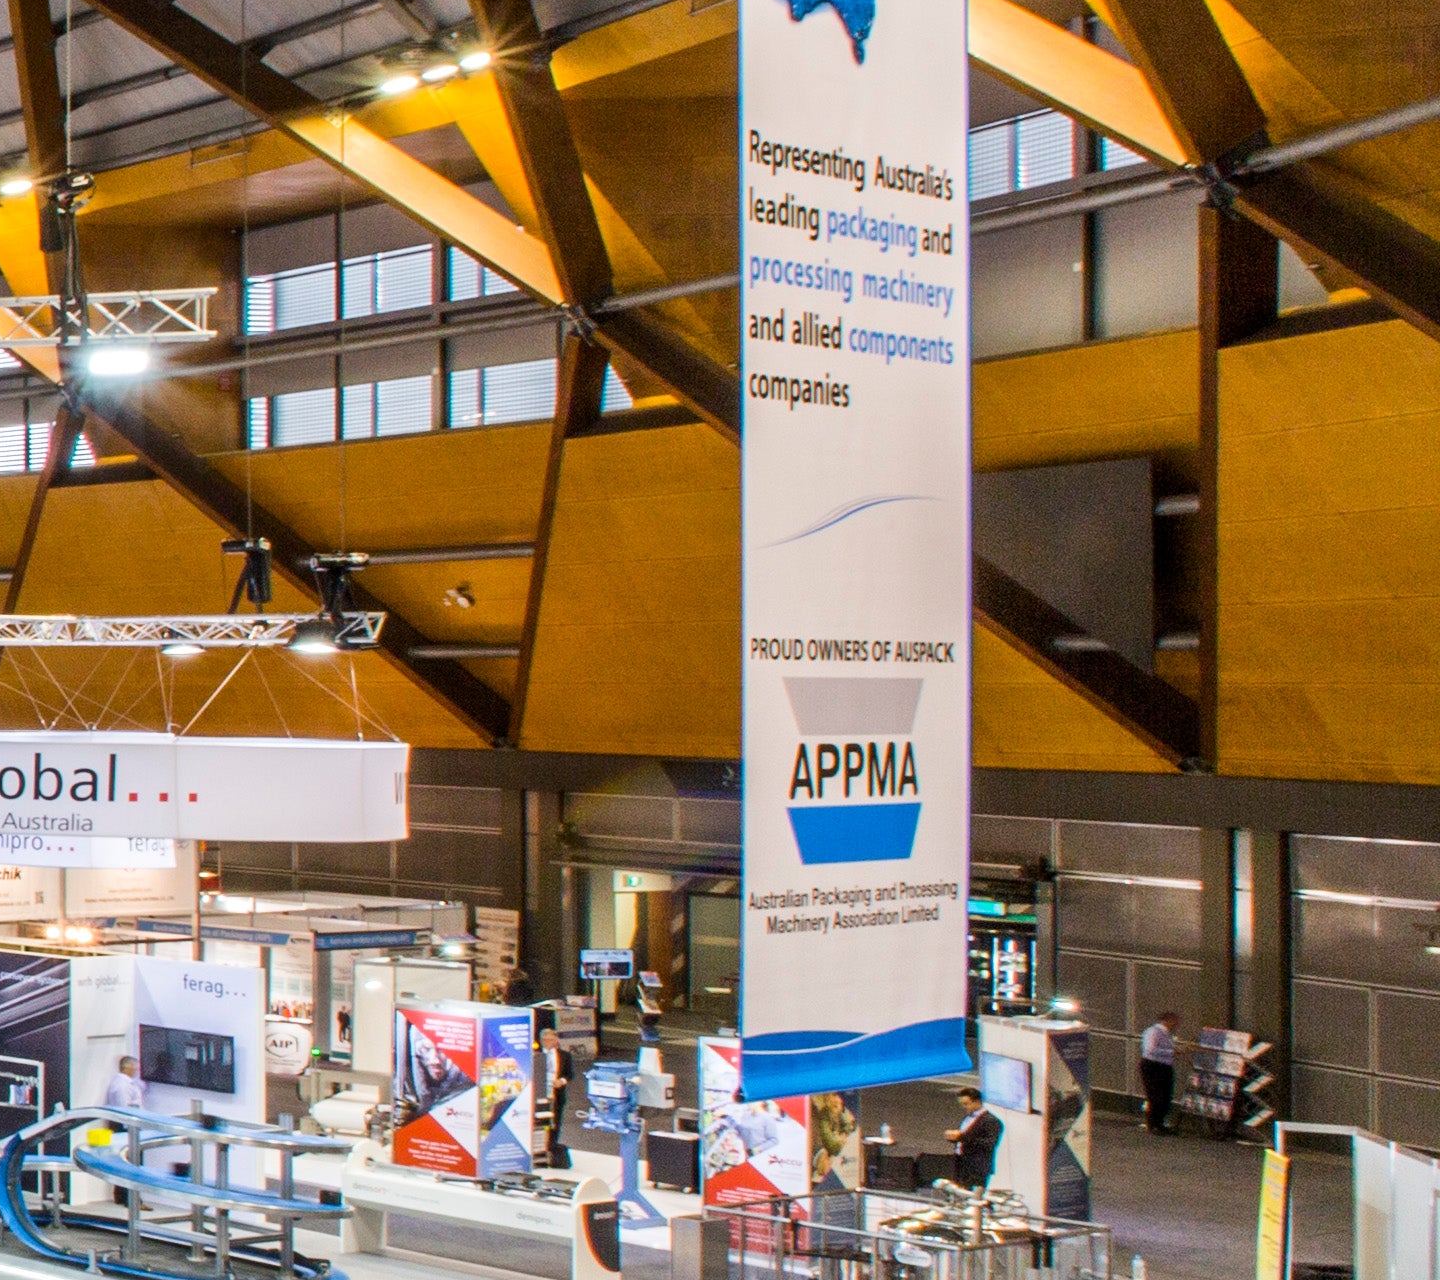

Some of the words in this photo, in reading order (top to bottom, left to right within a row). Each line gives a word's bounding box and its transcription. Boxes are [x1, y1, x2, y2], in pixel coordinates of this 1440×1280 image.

[749, 129, 864, 192] Representing
[874, 156, 953, 201] Australia's
[750, 186, 820, 241] leading
[827, 206, 917, 258] packaging
[922, 224, 952, 255] and
[750, 254, 852, 303] processing
[863, 270, 953, 318] machinery
[749, 308, 784, 341] and
[792, 311, 842, 349] allied
[849, 324, 953, 365] components
[749, 370, 850, 410] companies
[751, 638, 803, 660] PROUD
[807, 639, 868, 661] OWNERS
[872, 640, 891, 661] OF
[895, 641, 954, 663] AUSPACK
[789, 741, 918, 800] APPMA
[1, 812, 93, 832] Australia
[749, 889, 808, 910] Australian
[812, 884, 872, 908] Packaging
[874, 882, 896, 901] and
[899, 879, 958, 900] Processing
[767, 914, 829, 935] Machinery
[833, 907, 899, 929] Association
[901, 903, 939, 924] Limited
[269, 1039, 294, 1049] AIP
